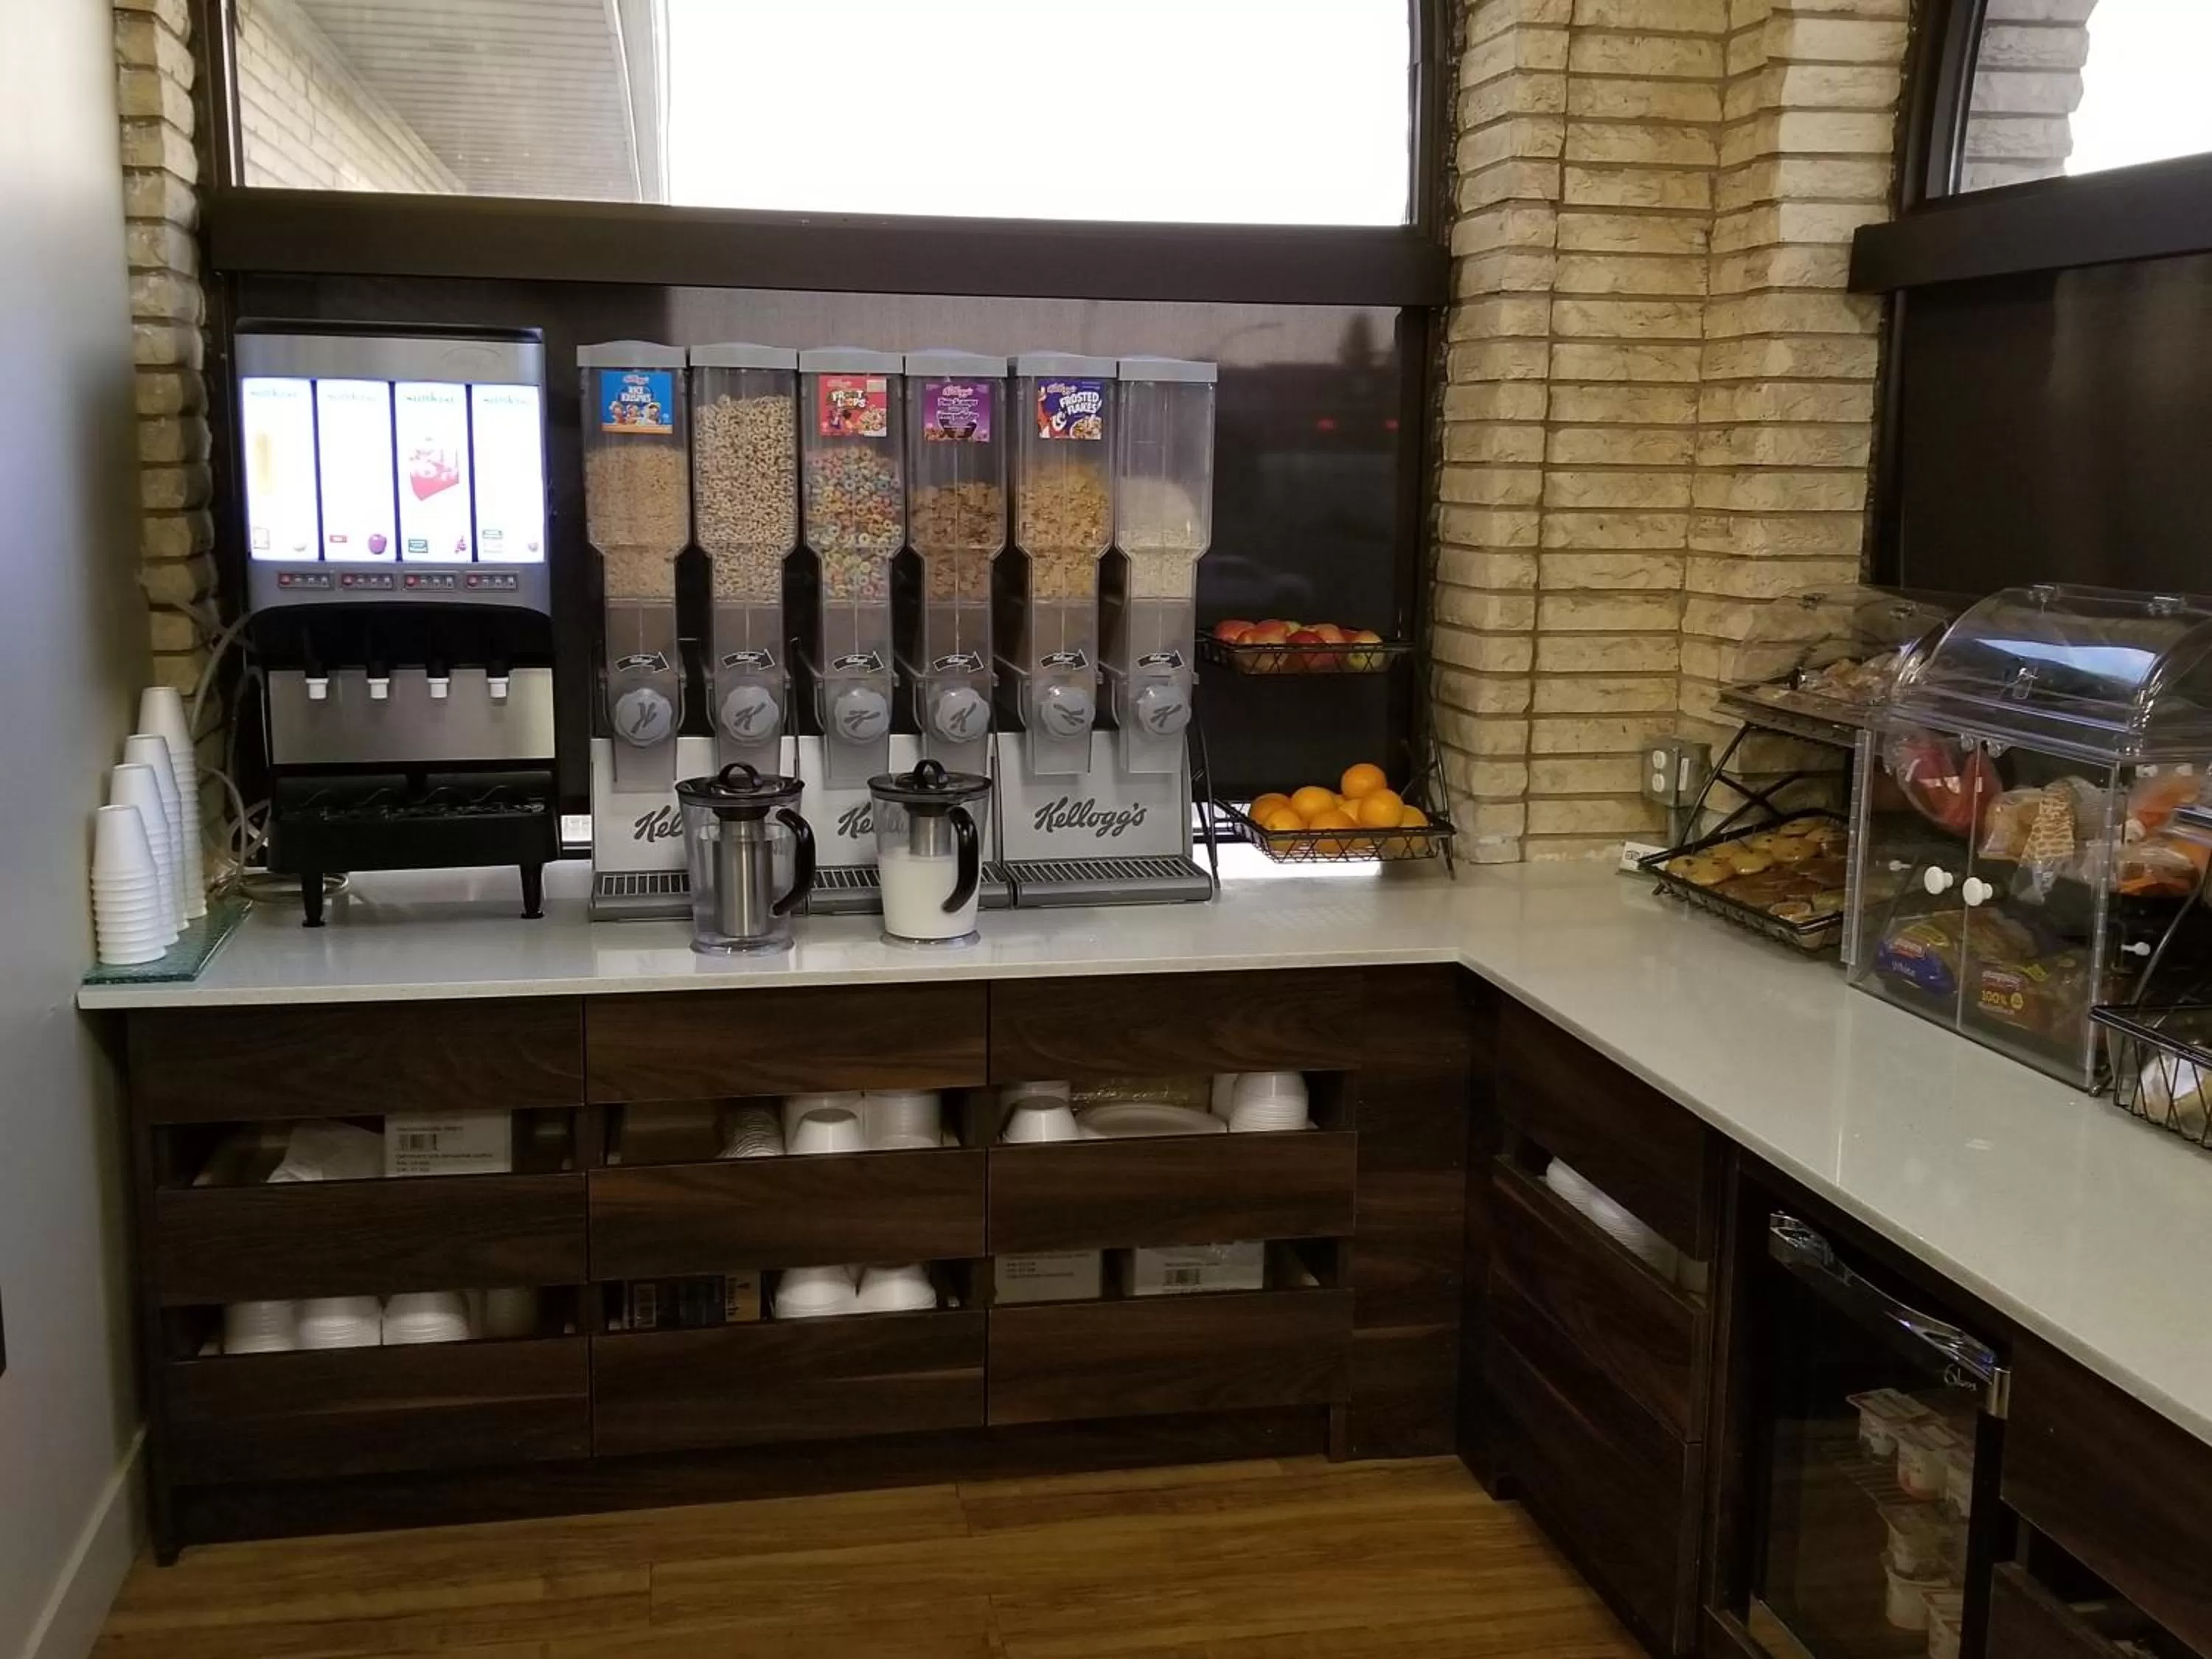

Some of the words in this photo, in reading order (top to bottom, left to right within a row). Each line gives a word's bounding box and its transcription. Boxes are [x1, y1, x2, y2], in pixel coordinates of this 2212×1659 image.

[1060, 392, 1099, 408] FROSTED
[1067, 401, 1100, 416] FLAKES
[1034, 796, 1147, 838] Kellogg's
